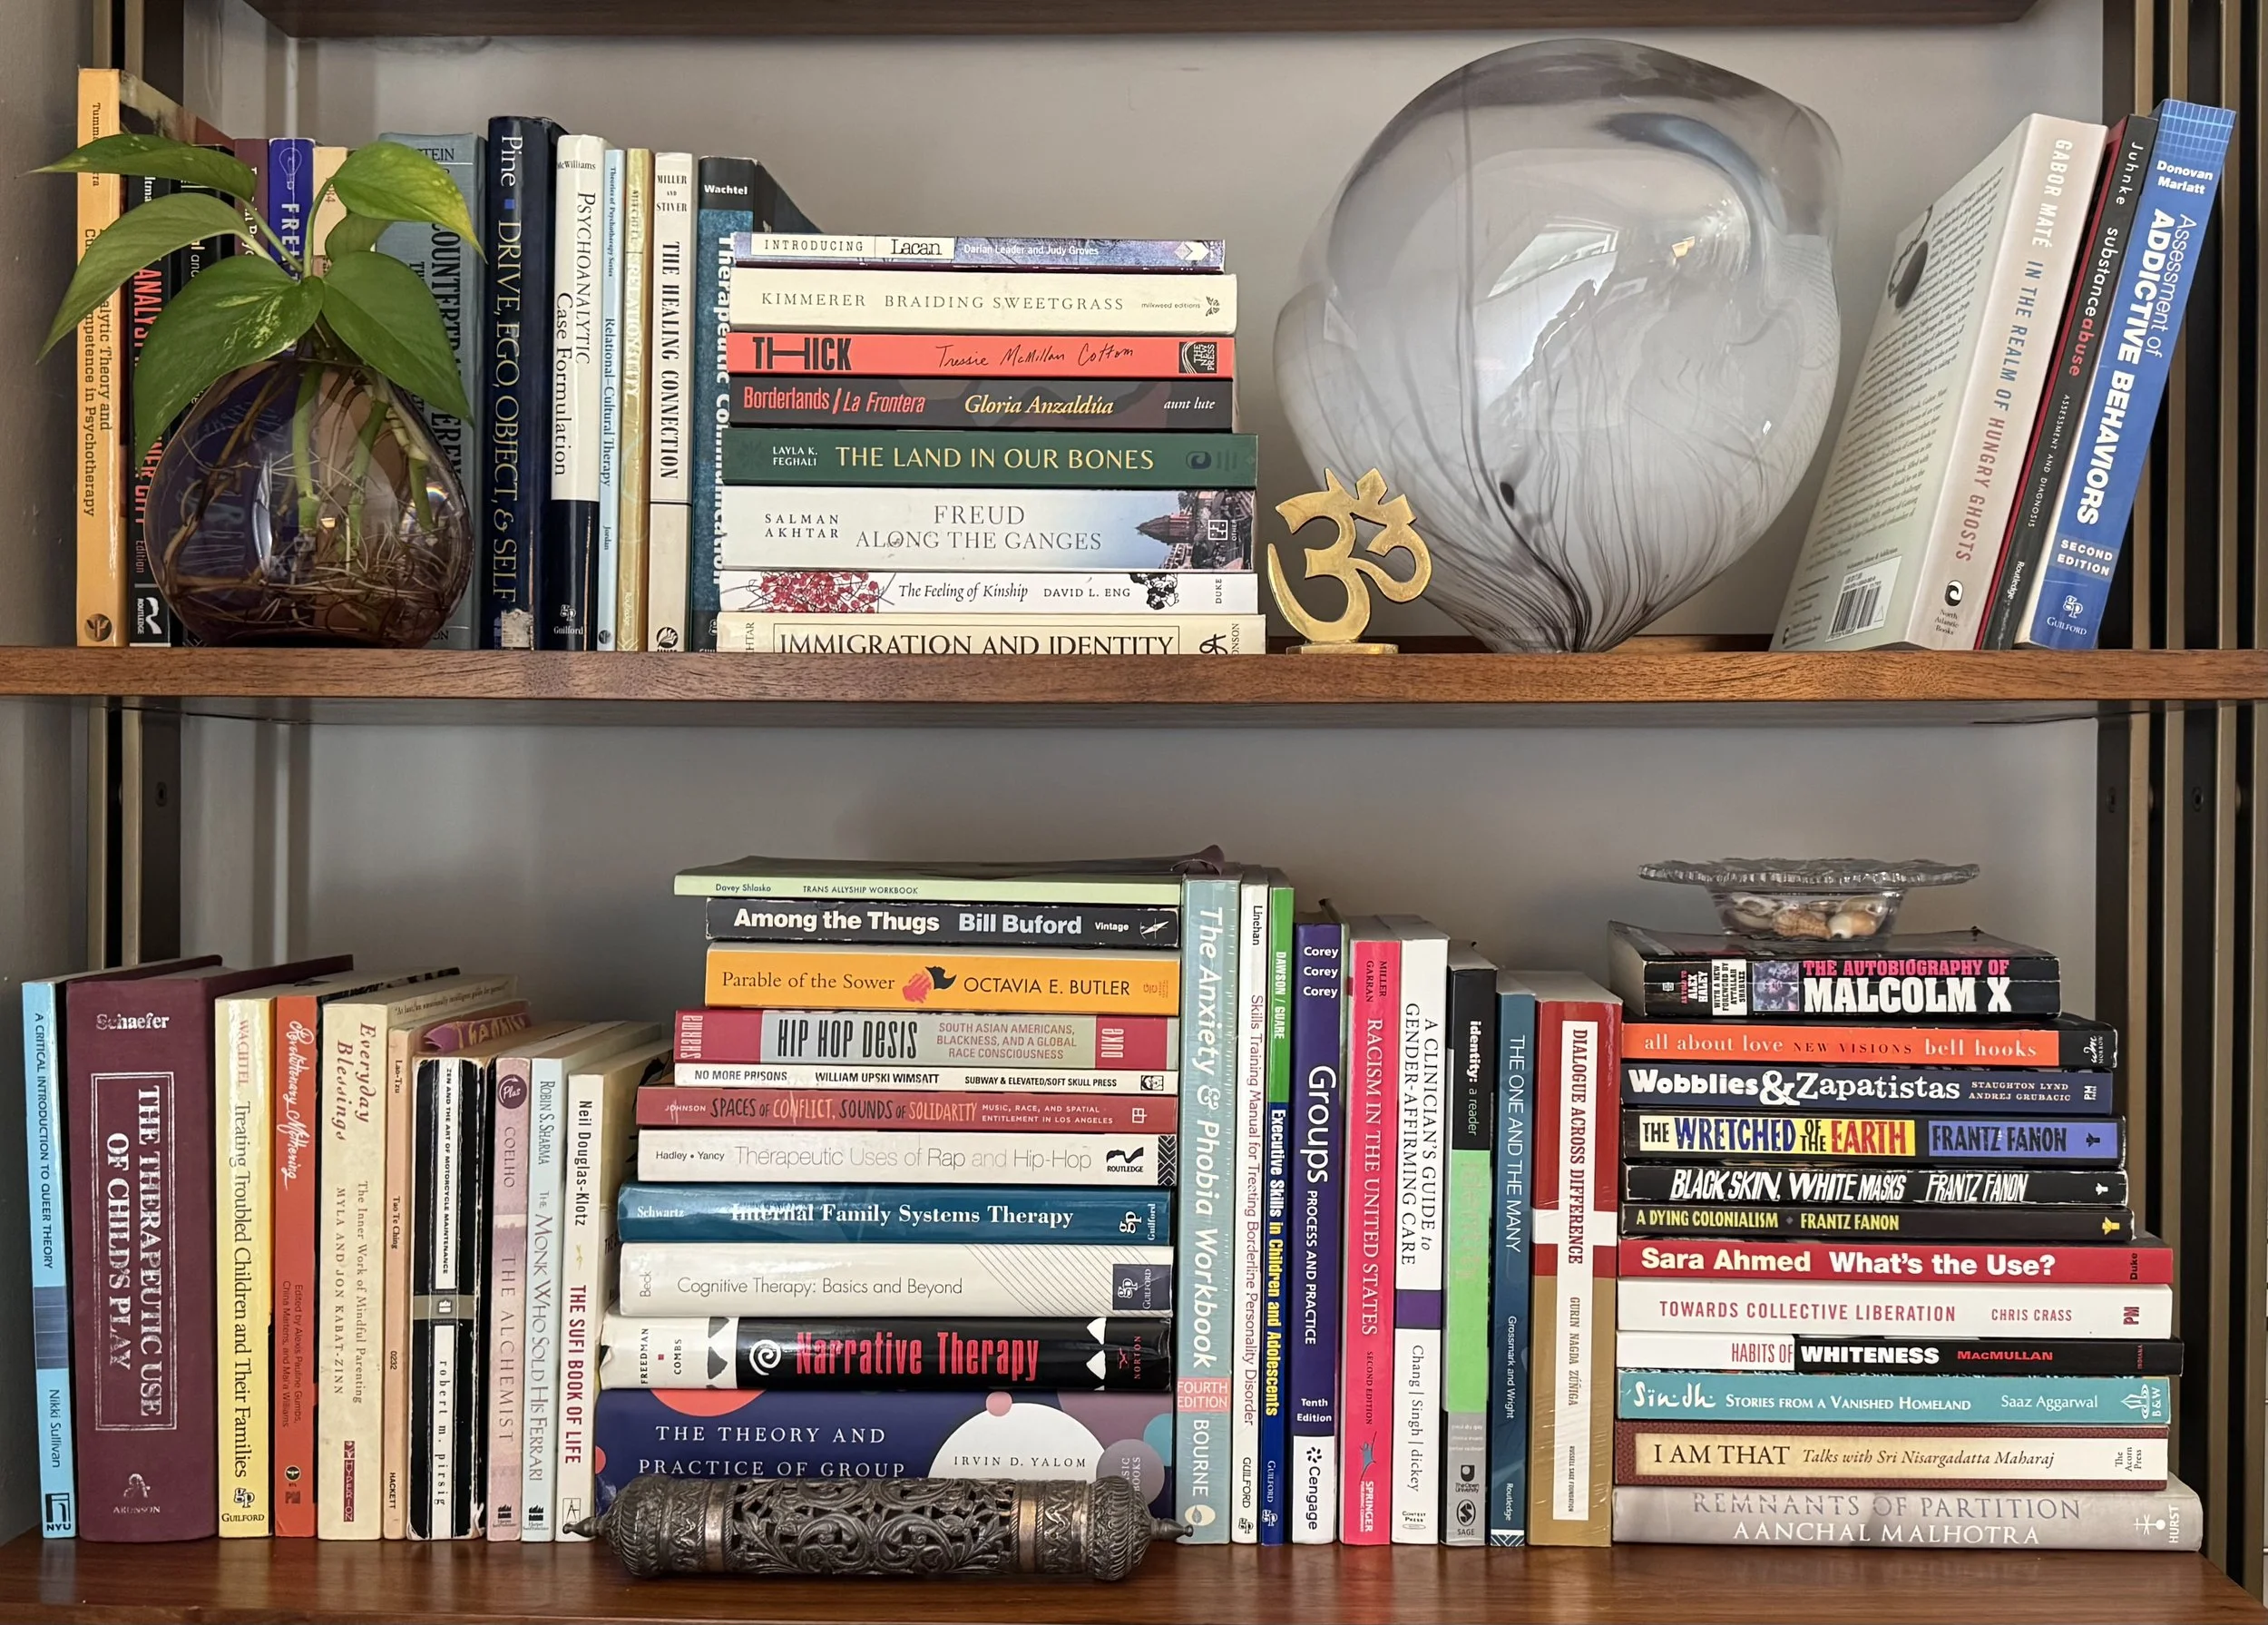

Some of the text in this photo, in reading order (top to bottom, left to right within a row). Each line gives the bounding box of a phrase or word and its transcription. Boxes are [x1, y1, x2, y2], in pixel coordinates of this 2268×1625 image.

[499, 135, 523, 187] Pine
[2156, 161, 2214, 181] Donovan
[656, 175, 687, 184] MILLER
[2115, 142, 2144, 205] Juhnke
[703, 185, 748, 195] Wachtel
[2157, 177, 2205, 194] Marlatt
[656, 203, 687, 212] STIVER
[763, 239, 943, 255] INTRODUCING Lacan
[494, 220, 522, 315] DRIVE,
[575, 192, 596, 365] PSYCHOANALYTIC
[2144, 213, 2196, 358] Assessment of
[761, 292, 1124, 310] KIMMERER BRAIDING SWEETGRASS
[491, 321, 520, 387] EGO,
[660, 241, 679, 479] THE HEALING CONNECTION
[1955, 139, 2073, 562] GABOR MATÉ IN THE REALM OF HUNGRY GHOSTS
[2076, 209, 2175, 525] ADDICTIVE BEHAVIORS
[97, 347, 112, 430] Theory and
[554, 292, 573, 475] Case Formulation
[964, 395, 1216, 415] Gloria Anzaldúa aunt lute
[83, 387, 97, 516] in Psychotherapy
[491, 395, 519, 503] OBJECT,
[493, 509, 513, 532] &
[764, 514, 839, 524] SALMAN
[934, 505, 1025, 525] FREUD
[764, 527, 839, 538] AKHTAR
[855, 531, 1101, 551] ALONG THE GANGES
[2060, 540, 2113, 561] SECOND
[493, 539, 517, 602] SELF
[2057, 553, 2110, 576] EDITION
[1042, 588, 1130, 597] DAVID L. ENG
[1214, 578, 1222, 603] DUKE
[831, 886, 866, 894] ALLYSHIP
[868, 886, 918, 895] WORKBOOK
[733, 908, 1129, 935] Among the Thugs Bill Buford Vintage
[1252, 905, 1263, 945] Linehan
[1303, 946, 1338, 958] Corey
[722, 972, 894, 990] Parable of the Sower
[1303, 966, 1338, 978] Corey
[963, 976, 1041, 993] OCTAVIA
[1049, 979, 1063, 994] E.
[1069, 980, 1129, 995] BUTLER
[1302, 986, 1337, 998] Corey
[1803, 977, 2011, 1013] MALCOLM X
[1423, 1018, 1438, 1031] A
[354, 1023, 376, 1123] Everyday
[694, 1070, 787, 1081] NO MORE PRISONS
[331, 1040, 353, 1140] Blessings
[1968, 1092, 2070, 1101] ANDREJ GRUBACIC
[1971, 1081, 2068, 1091] STAUGHTON LYND
[982, 1104, 1011, 1113] MUSIC,
[1014, 1105, 1041, 1114] RACE,
[1065, 1105, 1100, 1113] SPATIAL
[982, 1115, 1039, 1123] ENTITLEMENT
[1073, 1116, 1113, 1124] ANGELES
[1192, 907, 1223, 1368] The Anxiety & Phobia Workbook
[1401, 1003, 1420, 1266] GENDER-AFFIRMING CARE
[106, 1133, 129, 1171] OF
[655, 1150, 725, 1162] Hadley Yancy
[573, 1101, 592, 1226] Neil Douglas-Klotz
[1299, 1066, 1336, 1344] Groups PROCESS AND PRACTICE
[1421, 1167, 1435, 1229] GUIDE
[1636, 1210, 1899, 1230] A DYING COLONIALISM FRANTZ FANON
[138, 1086, 162, 1416] THE THERAPEUTIC USE
[1421, 1234, 1431, 1252] to
[677, 1277, 963, 1299] Cognitive Therapy: Basics and Beyond
[1991, 1309, 2071, 1321] CHRIS CRASS
[109, 1296, 131, 1370] PLAY
[640, 1327, 649, 1385] FREEDMAN
[673, 1338, 682, 1375] COMBS
[795, 1332, 1039, 1382] Narrative Therapy
[1177, 1381, 1227, 1394] FOURTH
[1177, 1396, 1227, 1409] EDITION
[1300, 1398, 1327, 1406] Tenth
[2000, 1395, 2097, 1411] Saaz Aggarwal
[48, 1389, 62, 1468] Nikki Sullivan
[1295, 1414, 1332, 1423] Edition
[953, 1456, 1086, 1468] IRVIN D. YALOM
[1192, 1420, 1209, 1496] BOURNE
[1305, 1467, 1325, 1530] Cengage
[1733, 1522, 2039, 1544] AANCHAL MALHOTRA
